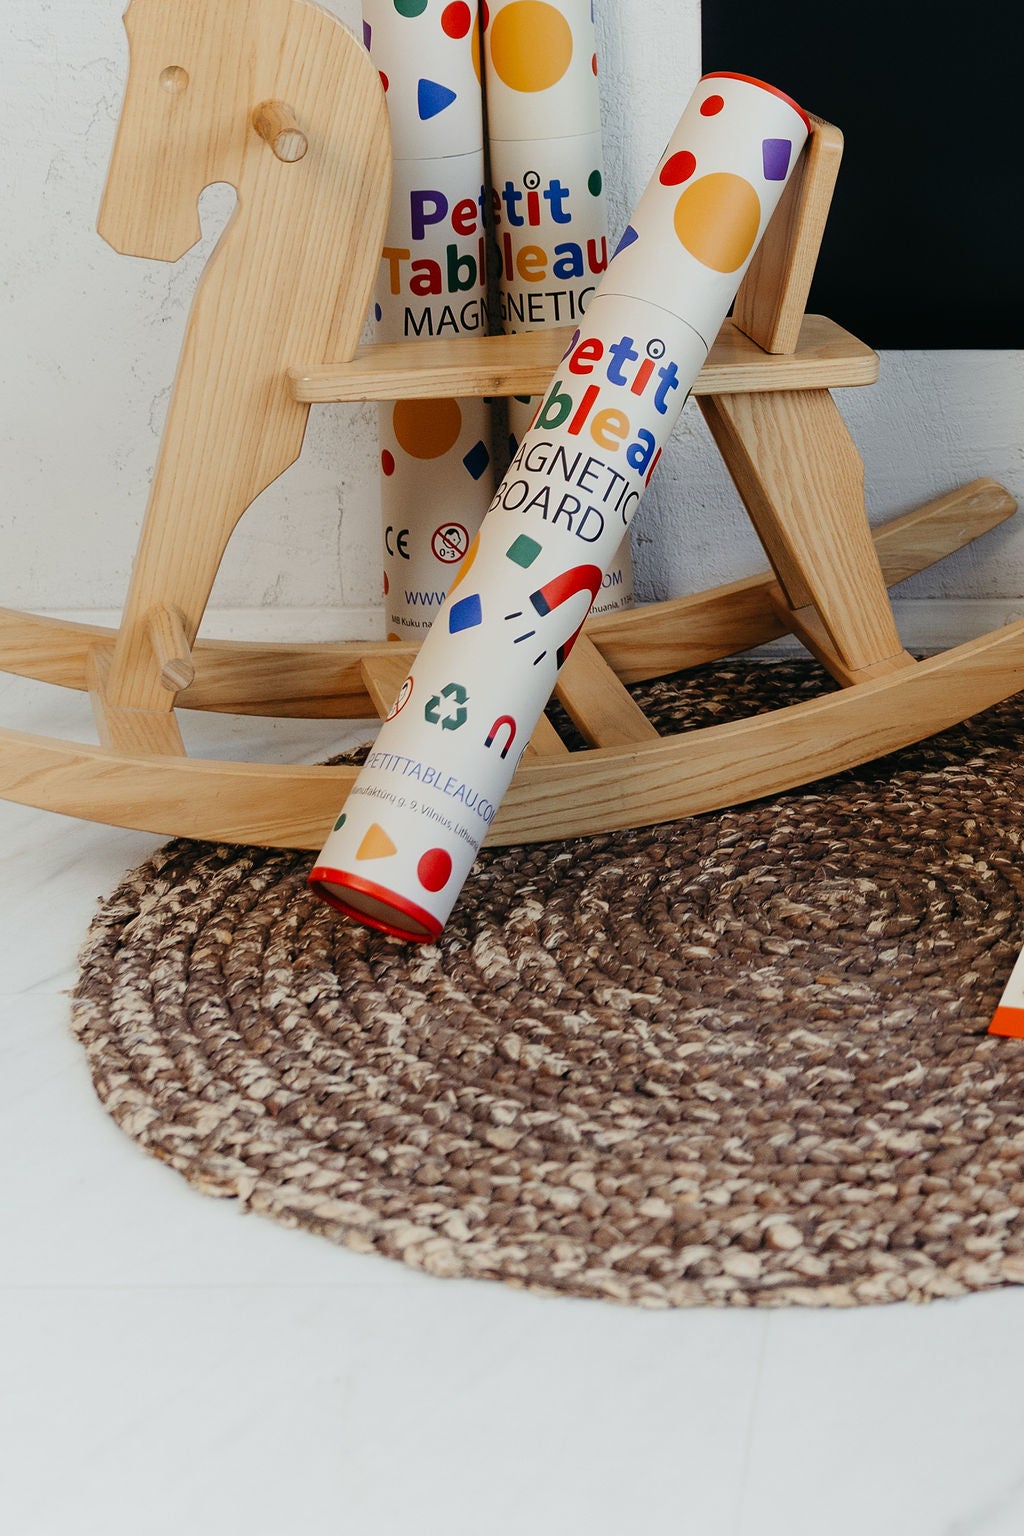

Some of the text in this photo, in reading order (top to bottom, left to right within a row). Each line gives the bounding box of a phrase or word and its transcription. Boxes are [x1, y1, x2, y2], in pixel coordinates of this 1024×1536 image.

[497, 232, 608, 283] leau
[561, 329, 679, 415] etit
[401, 617, 420, 628] Kuku
